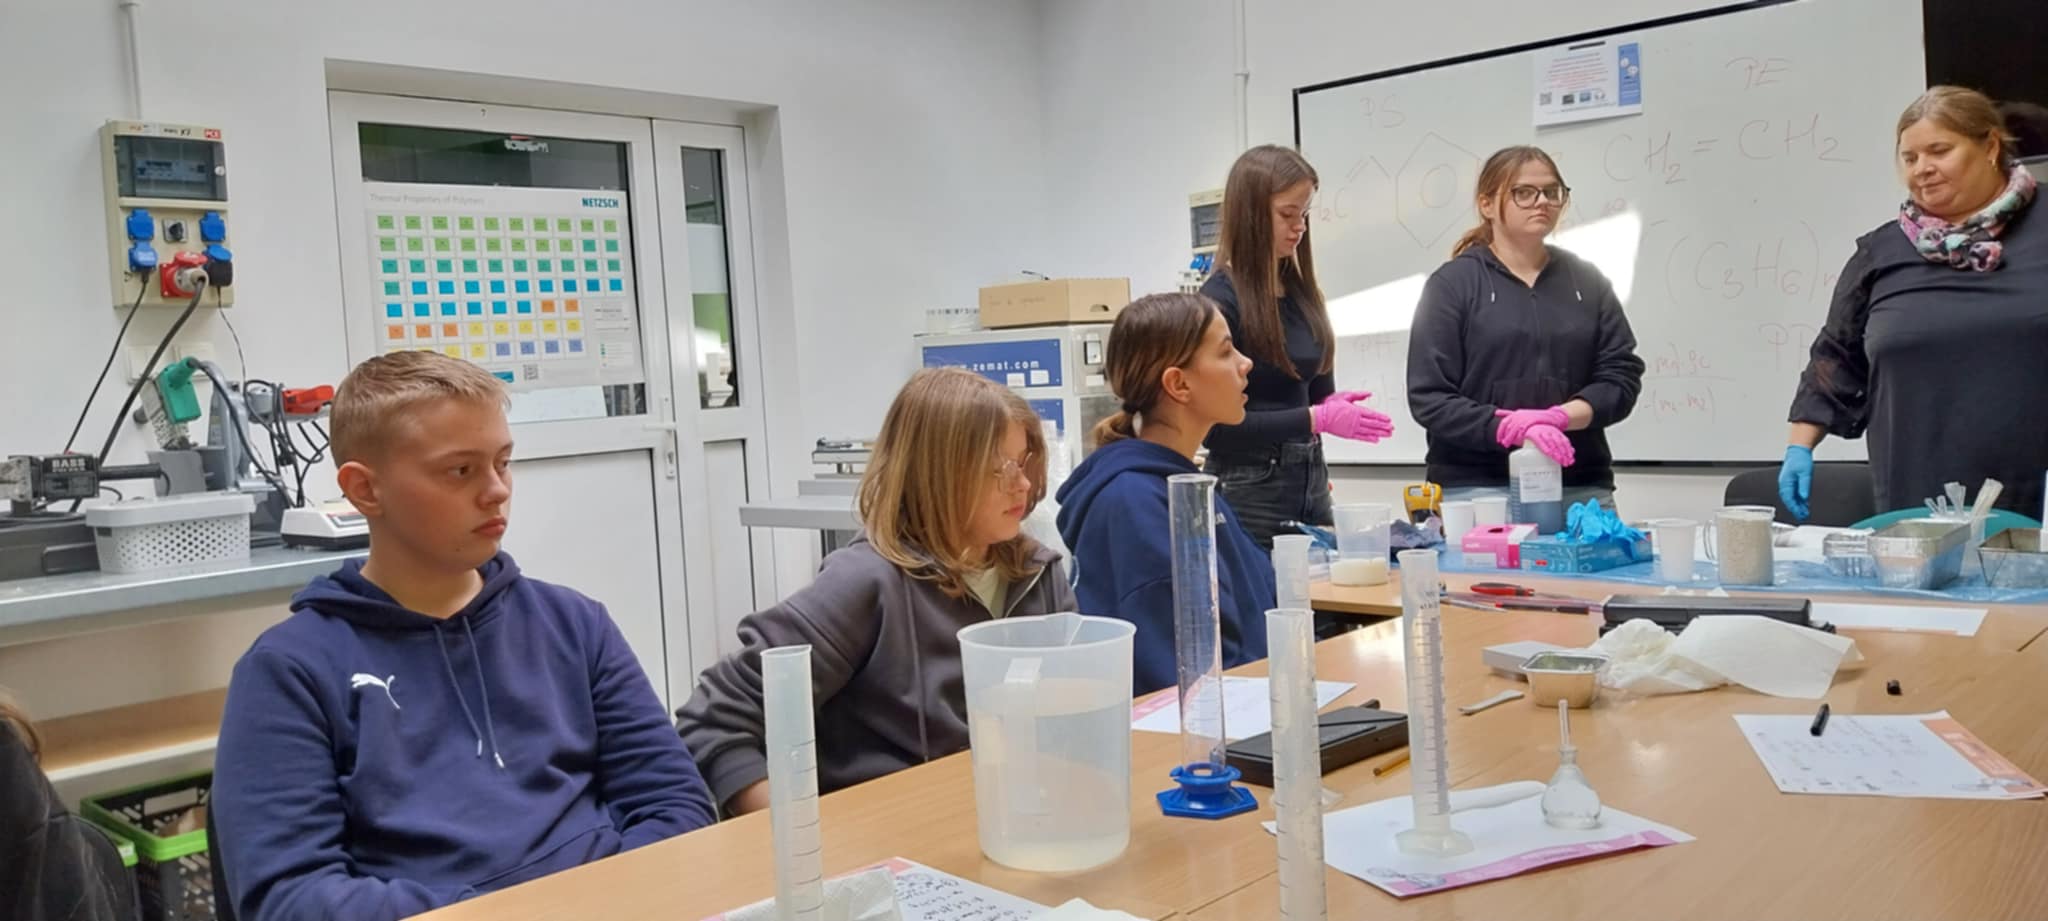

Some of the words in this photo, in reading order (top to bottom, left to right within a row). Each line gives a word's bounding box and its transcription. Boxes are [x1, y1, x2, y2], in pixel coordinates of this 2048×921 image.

[1726, 56, 1791, 90] PE
[1359, 94, 1406, 129] PS
[581, 197, 619, 209] NETZSCH
[52, 458, 86, 468] BASS
